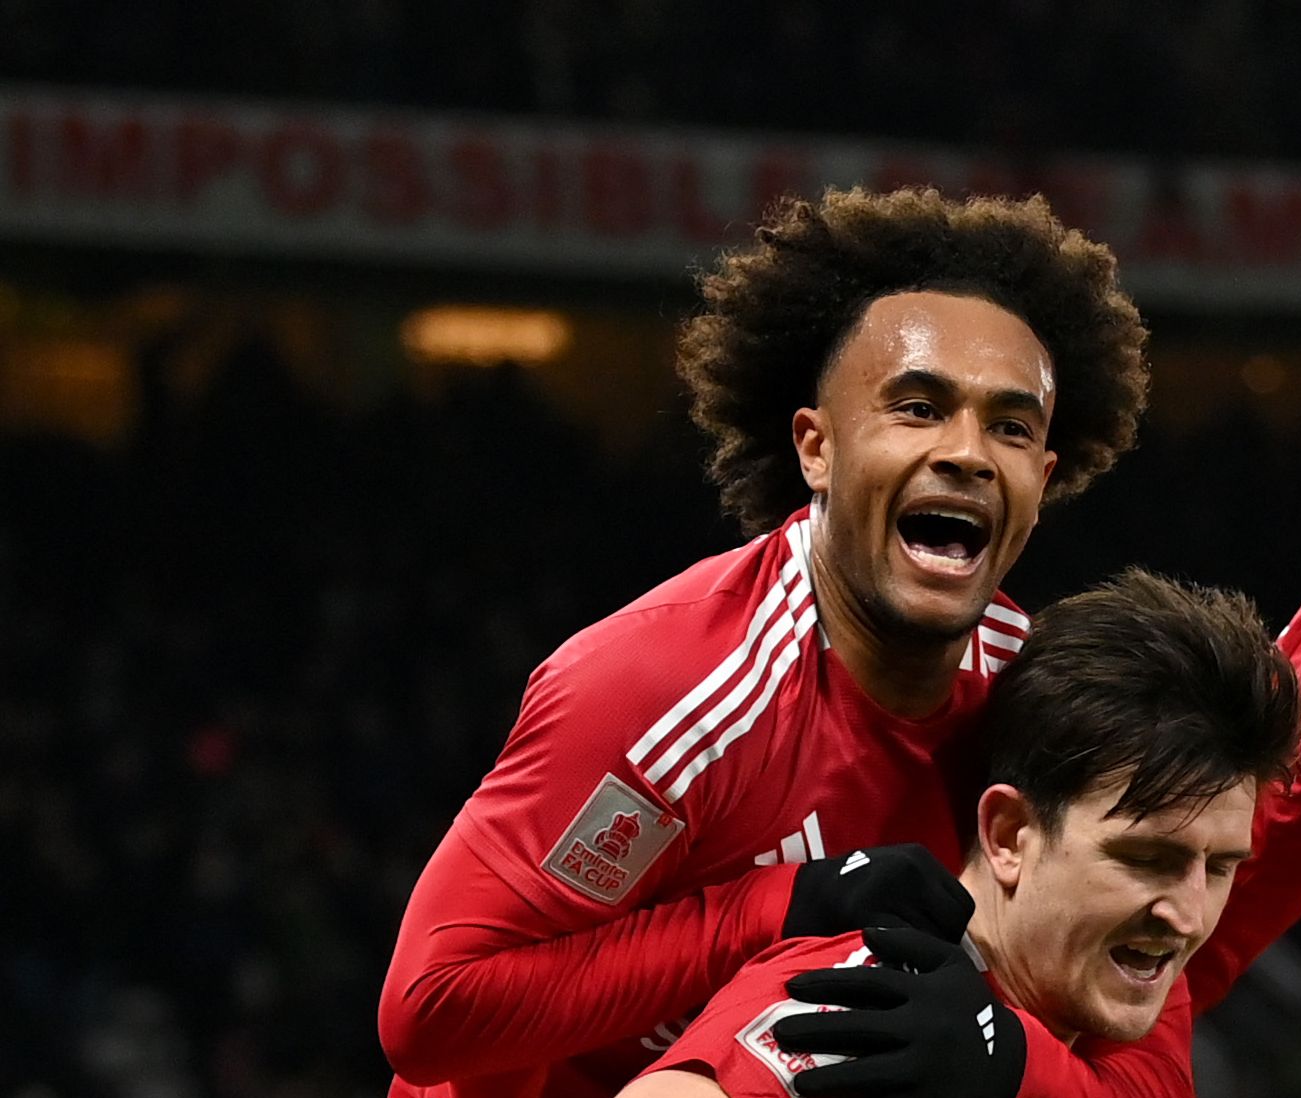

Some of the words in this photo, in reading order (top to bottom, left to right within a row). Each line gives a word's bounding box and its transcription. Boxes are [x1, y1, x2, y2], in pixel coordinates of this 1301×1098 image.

[561, 853, 583, 877] FA
[584, 867, 620, 891] CUP
[570, 840, 629, 881] Emirates
[756, 1030, 778, 1053] FA
